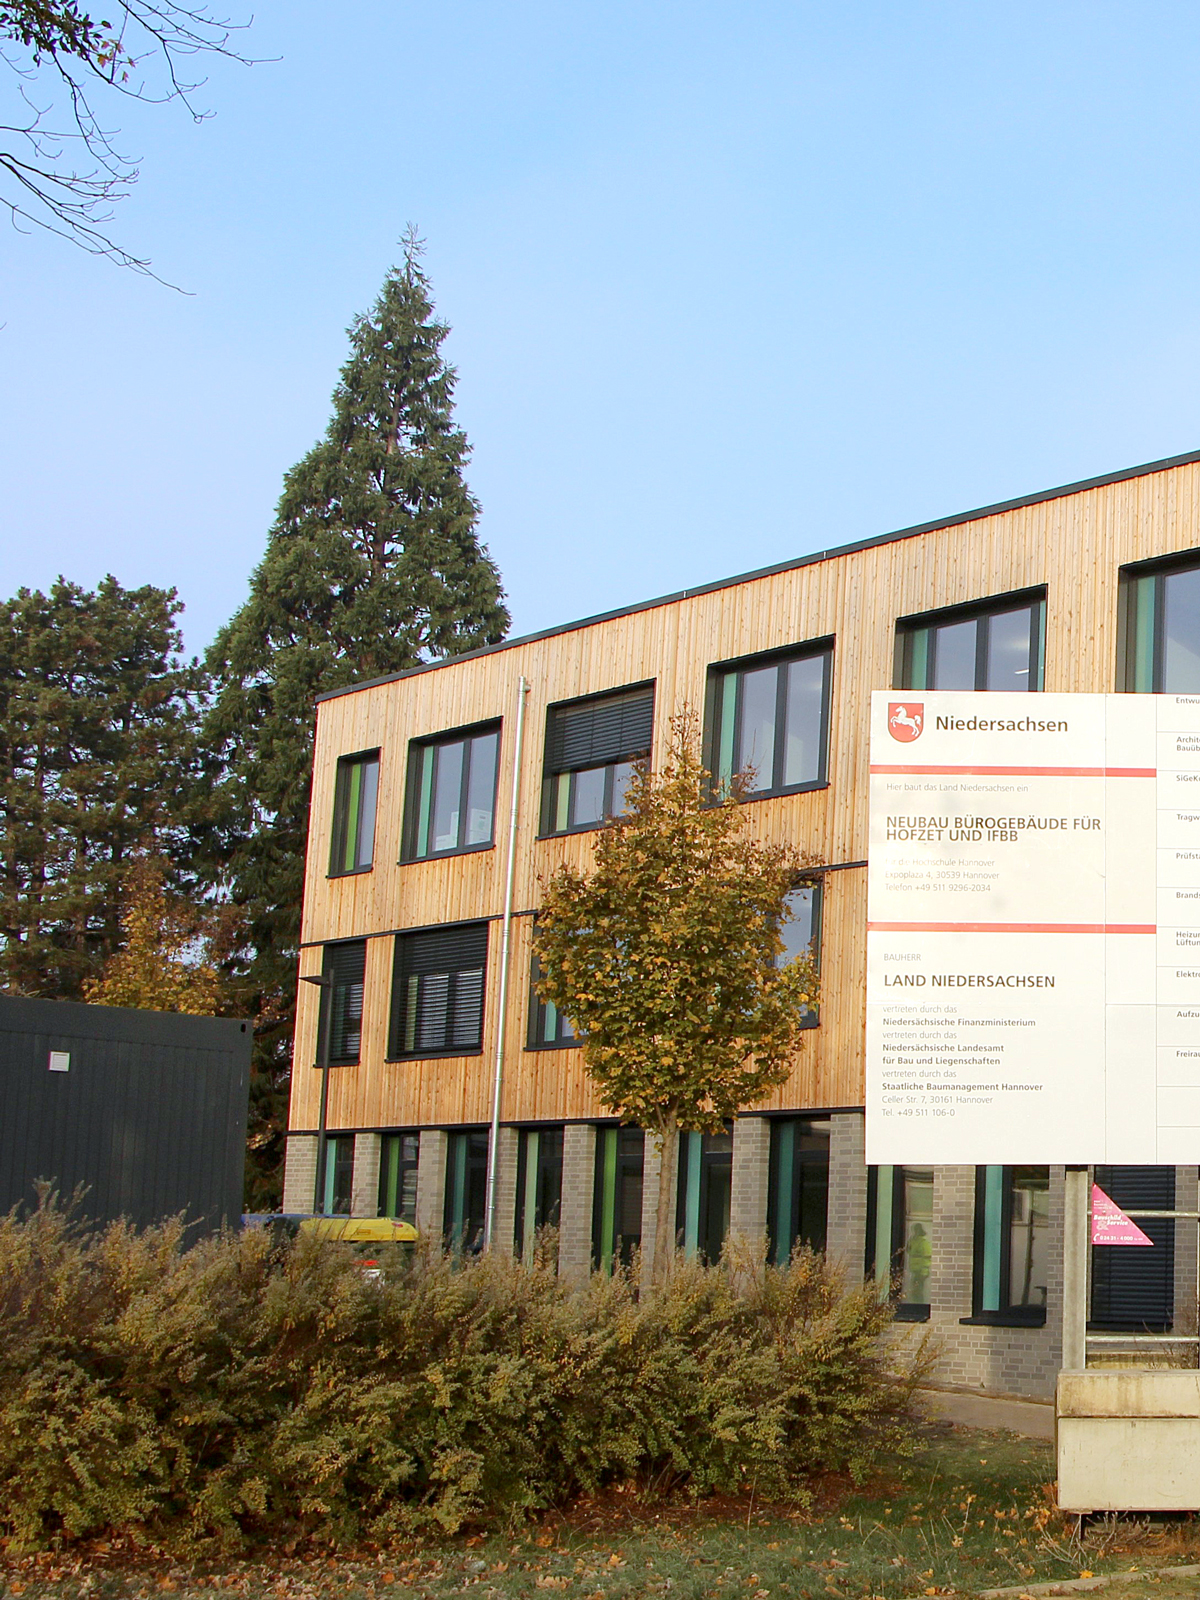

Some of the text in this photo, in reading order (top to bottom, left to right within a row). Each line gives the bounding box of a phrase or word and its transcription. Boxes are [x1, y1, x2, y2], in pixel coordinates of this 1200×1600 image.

[936, 717, 1067, 731] Niedersachsen
[886, 782, 1028, 792] Hier baut das Land Niedersachsen ein
[886, 814, 1100, 830] NEUBAU BÜROGEBÄUDE FÜR
[886, 829, 1018, 841] HOFZET UND IFBB
[958, 859, 995, 867] Hannover
[925, 871, 933, 880] 4,
[962, 871, 999, 879] Hannover
[886, 883, 990, 891] Telefon +49 511 9296-2034
[883, 953, 921, 961] BAUHERR
[884, 974, 1054, 987] LAND NIEDERSACHSEN
[882, 1005, 957, 1013] vertreten durch das
[882, 1018, 1035, 1026] Niedersächsische Finanzministerium
[882, 1031, 957, 1039] vertreten durch das
[882, 1044, 1004, 1052] Niedersächsische Landesamt
[882, 1056, 1000, 1066] für Bau und Liegenschaften
[881, 1069, 956, 1078] vertreten durch das
[882, 1082, 1042, 1092] Staatliche Baumanagement Hannover
[881, 1095, 904, 1103] Celler
[921, 1096, 927, 1105] 7,
[929, 1096, 952, 1104] 30161
[955, 1096, 993, 1104] Hannover
[882, 1108, 955, 1116] Tel. +49 511 106-0
